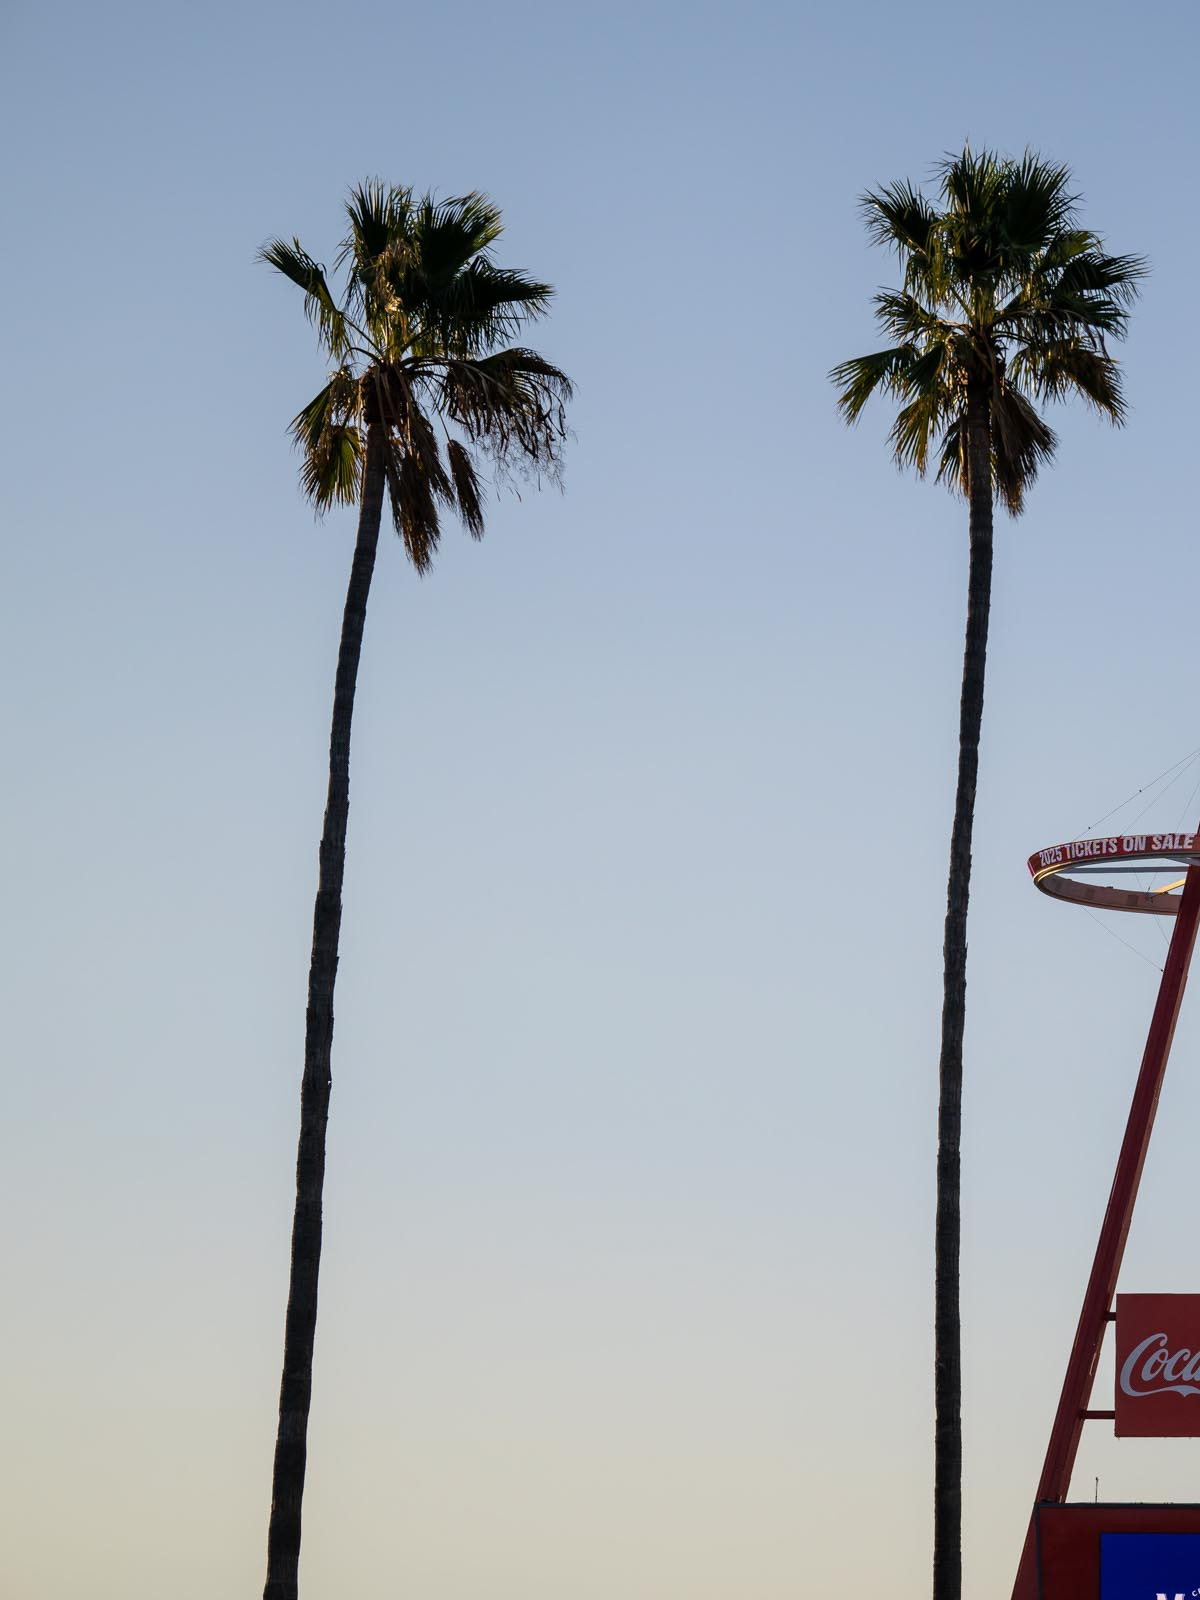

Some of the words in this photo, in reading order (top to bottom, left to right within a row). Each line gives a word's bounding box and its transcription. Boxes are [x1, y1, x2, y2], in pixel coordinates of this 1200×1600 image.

[1039, 849, 1062, 867] 2025
[1062, 838, 1118, 863] TICKETS
[1123, 835, 1146, 851] ON
[1152, 833, 1195, 850] SALE
